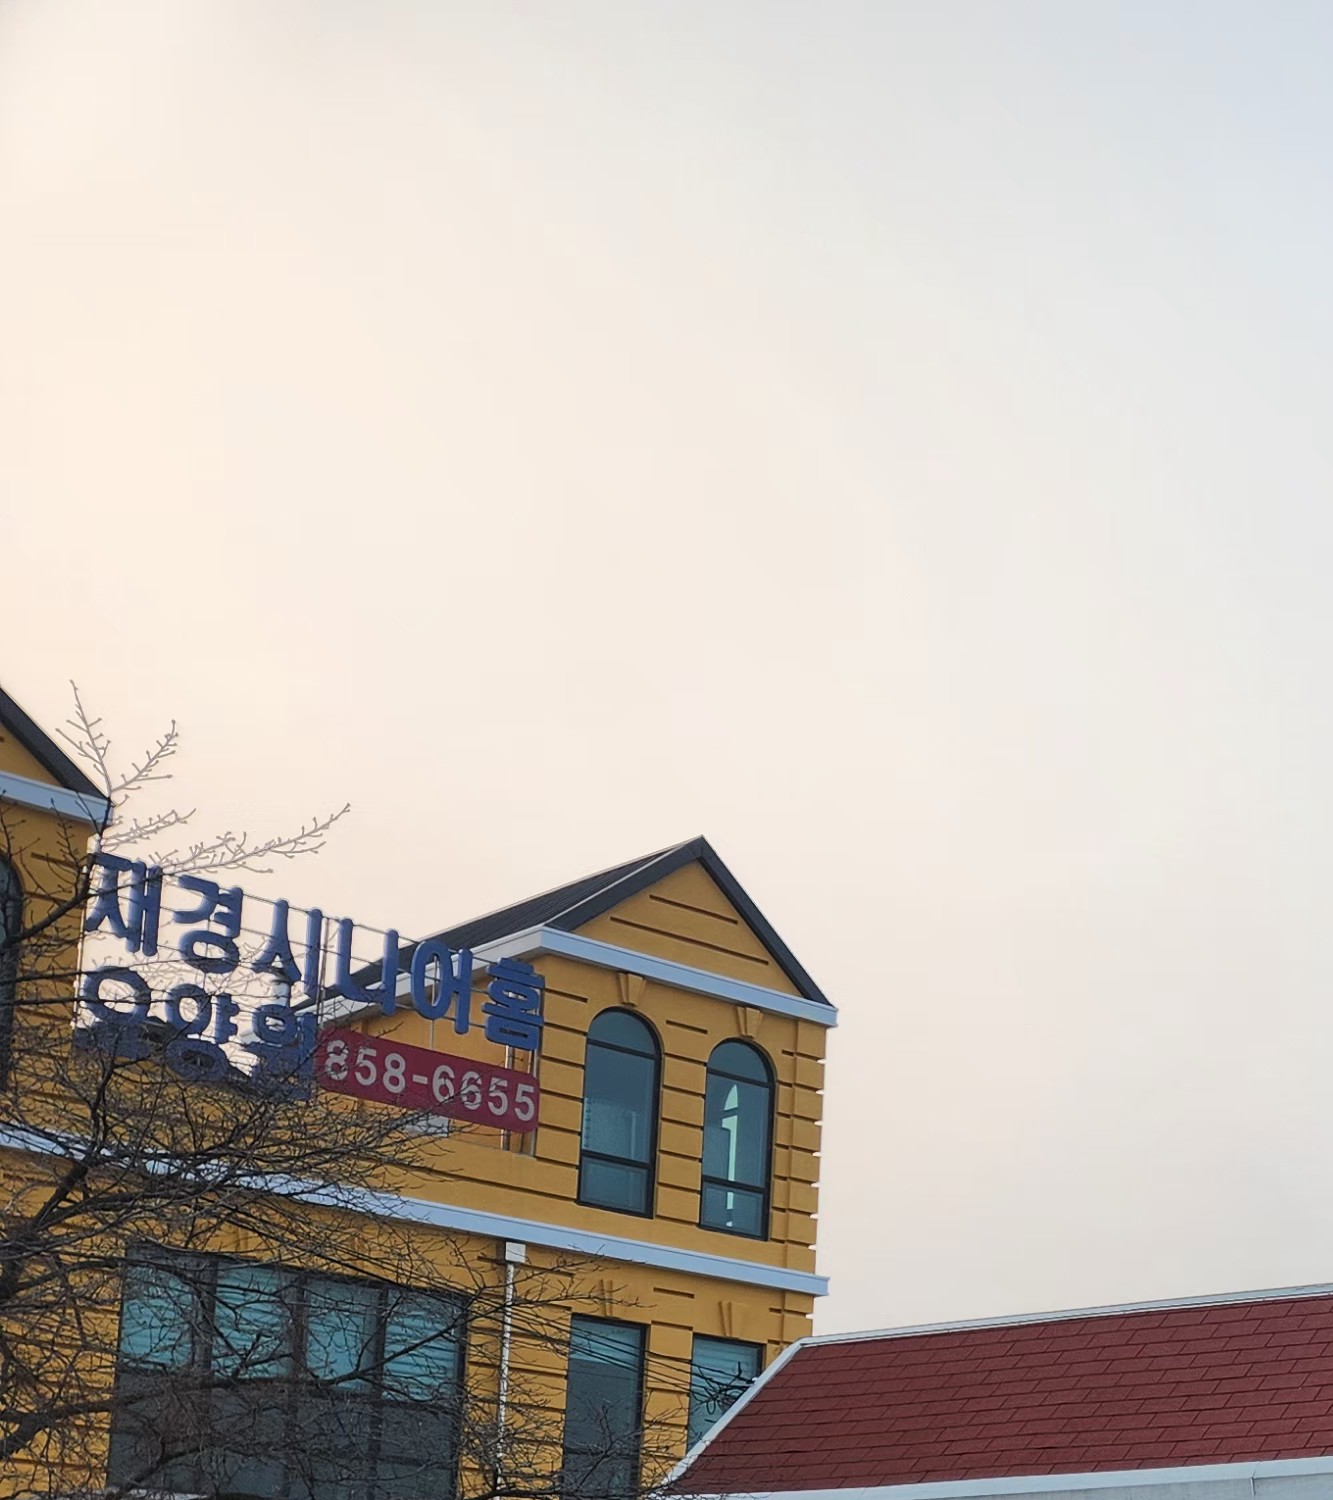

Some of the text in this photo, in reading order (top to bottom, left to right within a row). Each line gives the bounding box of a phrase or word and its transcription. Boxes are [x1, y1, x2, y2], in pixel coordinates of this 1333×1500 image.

[84, 851, 546, 1051] 재경시니어홈
[73, 965, 317, 1101] 요양원
[324, 1039, 536, 1122] 858-6655
